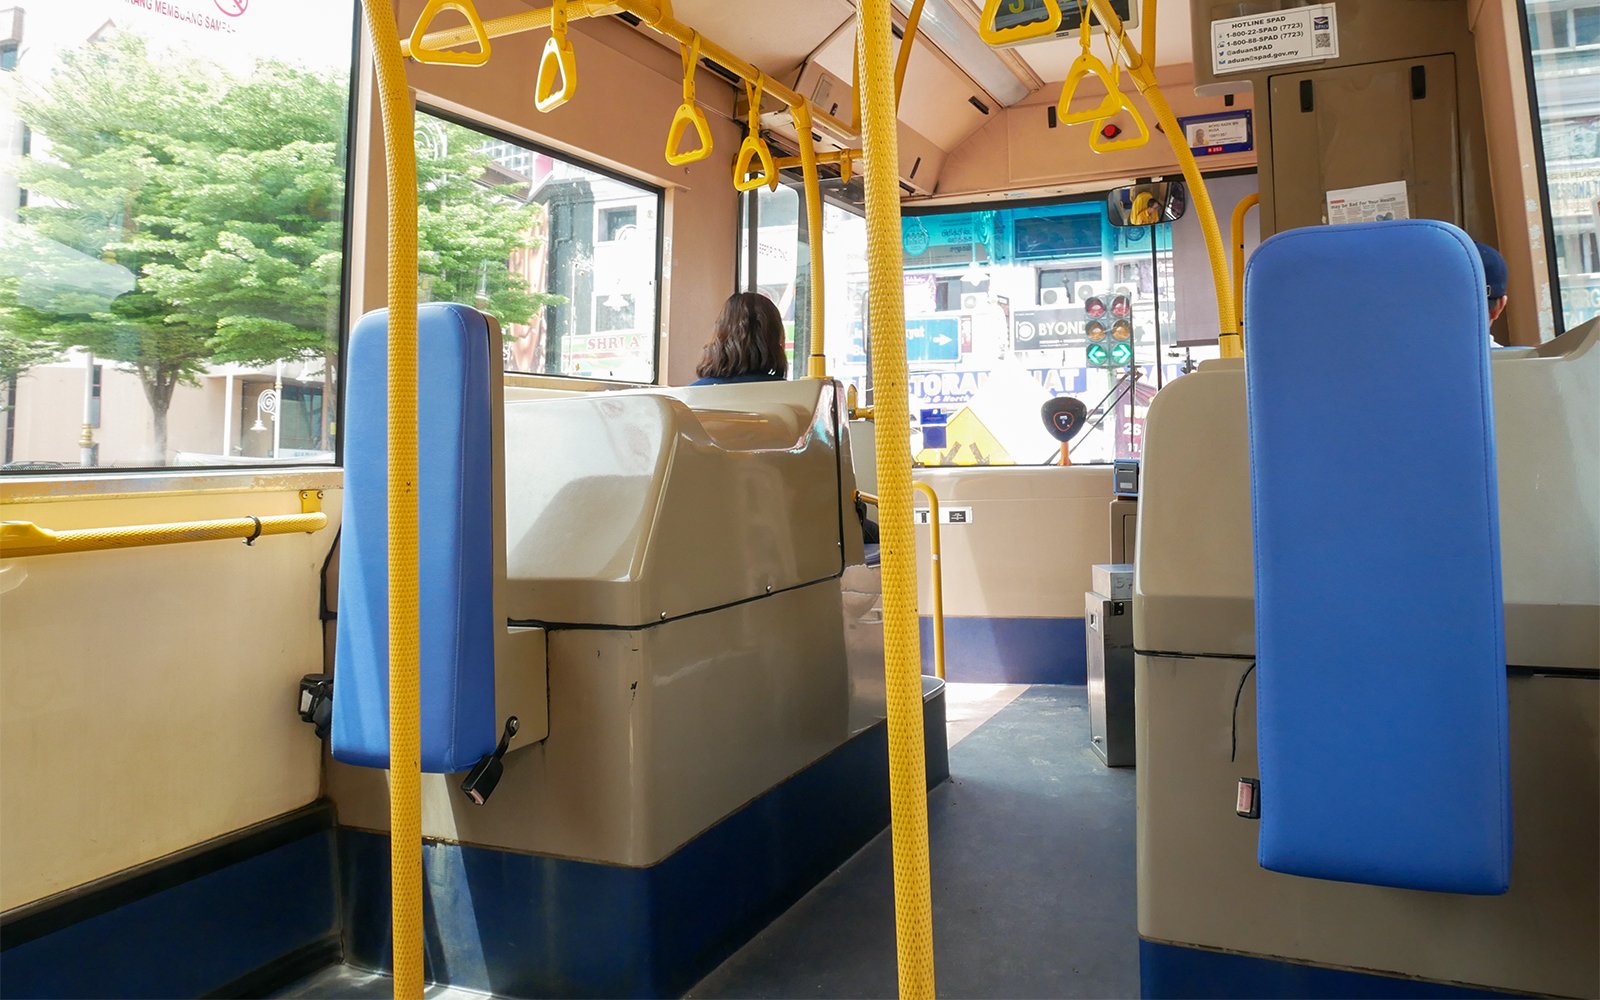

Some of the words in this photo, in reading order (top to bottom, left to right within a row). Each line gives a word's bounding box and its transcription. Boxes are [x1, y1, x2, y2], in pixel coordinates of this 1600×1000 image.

[1231, 19, 1265, 29] HOTLINE
[1266, 16, 1286, 24] SPAD
[1226, 26, 1278, 39] 1-800-22-SPAD
[1279, 22, 1304, 32] (7723)
[1226, 34, 1279, 47] 1-800-88-SPAD
[1280, 31, 1304, 40] (7723)
[1226, 44, 1273, 56] @aduanSPAD
[1227, 50, 1299, 65] aduan@spad.gov.my
